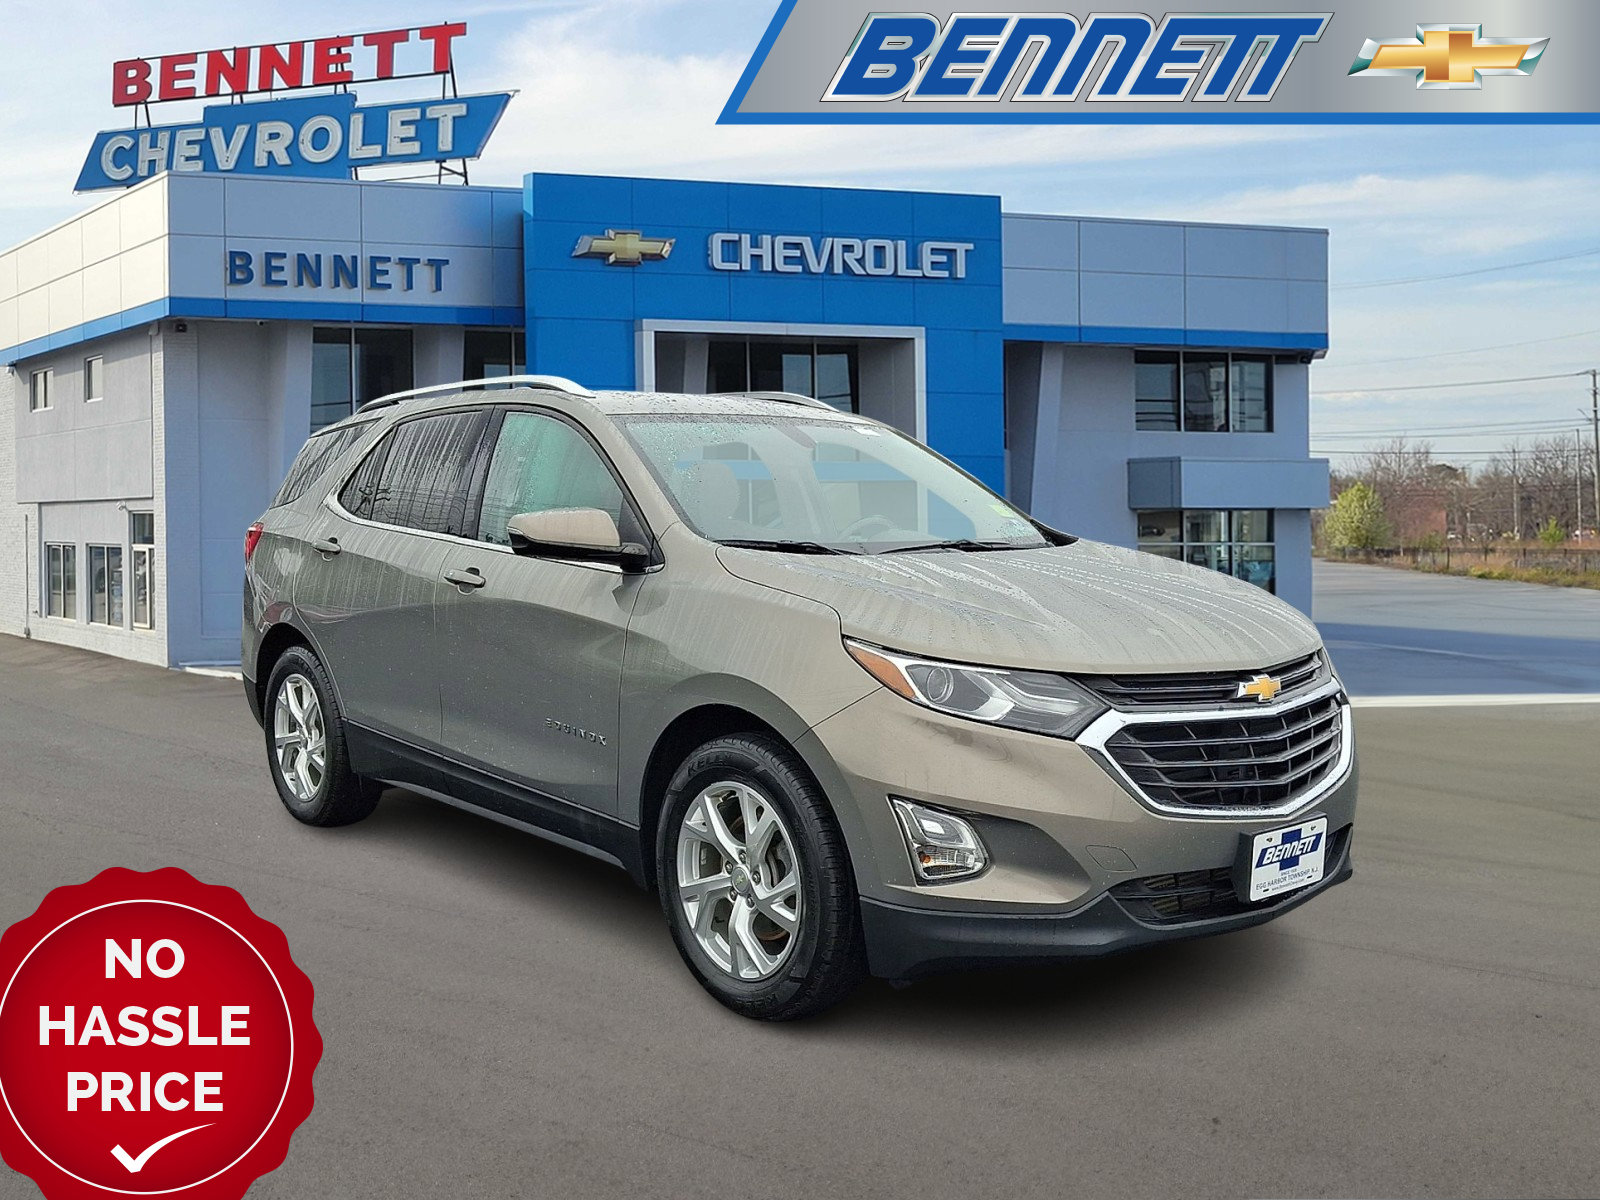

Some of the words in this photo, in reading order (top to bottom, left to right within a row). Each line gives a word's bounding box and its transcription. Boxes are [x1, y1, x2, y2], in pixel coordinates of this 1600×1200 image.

[112, 22, 467, 106] BENNETT
[100, 102, 468, 181] CHEVROLET
[227, 249, 450, 292] BENNETT
[708, 232, 975, 279] CHEVROLET
[1262, 836, 1316, 865] BENNETT
